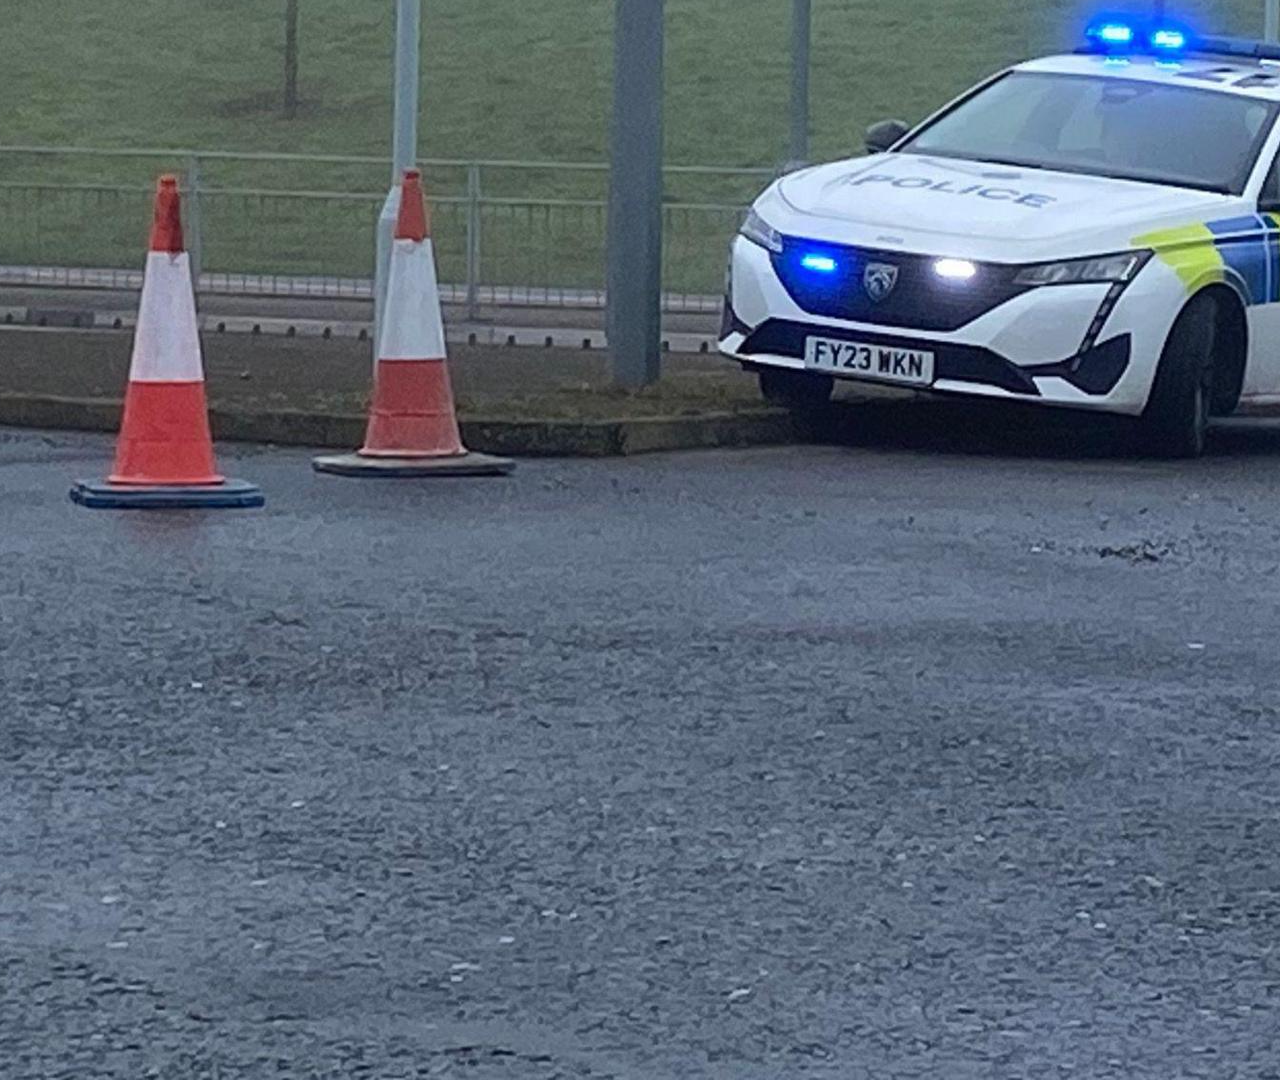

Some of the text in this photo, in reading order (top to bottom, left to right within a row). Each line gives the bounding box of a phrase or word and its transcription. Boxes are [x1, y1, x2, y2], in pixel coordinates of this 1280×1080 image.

[849, 173, 1058, 209] POLICE
[814, 341, 923, 377] FY23 WKN
